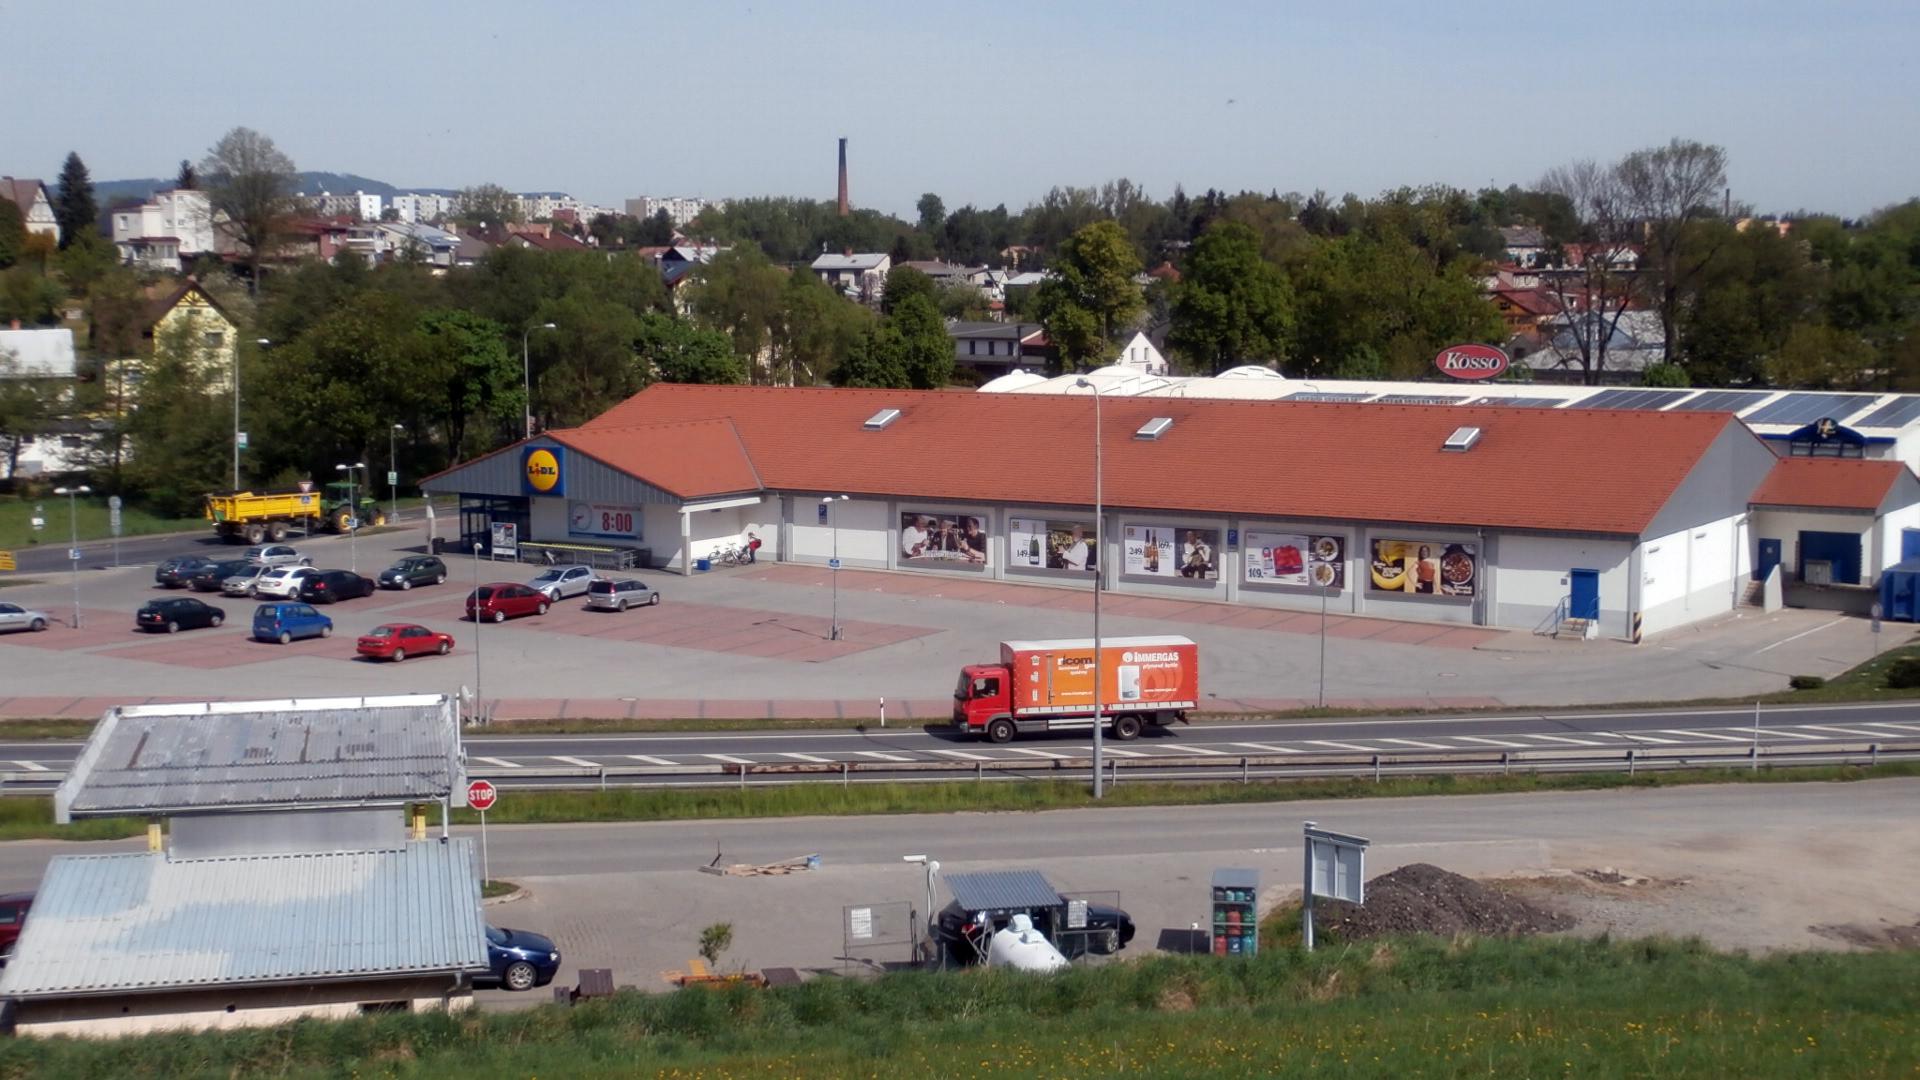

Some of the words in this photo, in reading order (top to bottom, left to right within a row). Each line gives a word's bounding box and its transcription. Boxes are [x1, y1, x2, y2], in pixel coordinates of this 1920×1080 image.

[602, 512, 632, 532] 8:00
[1134, 651, 1179, 663] IMMERGAS
[469, 788, 493, 801] STOP
